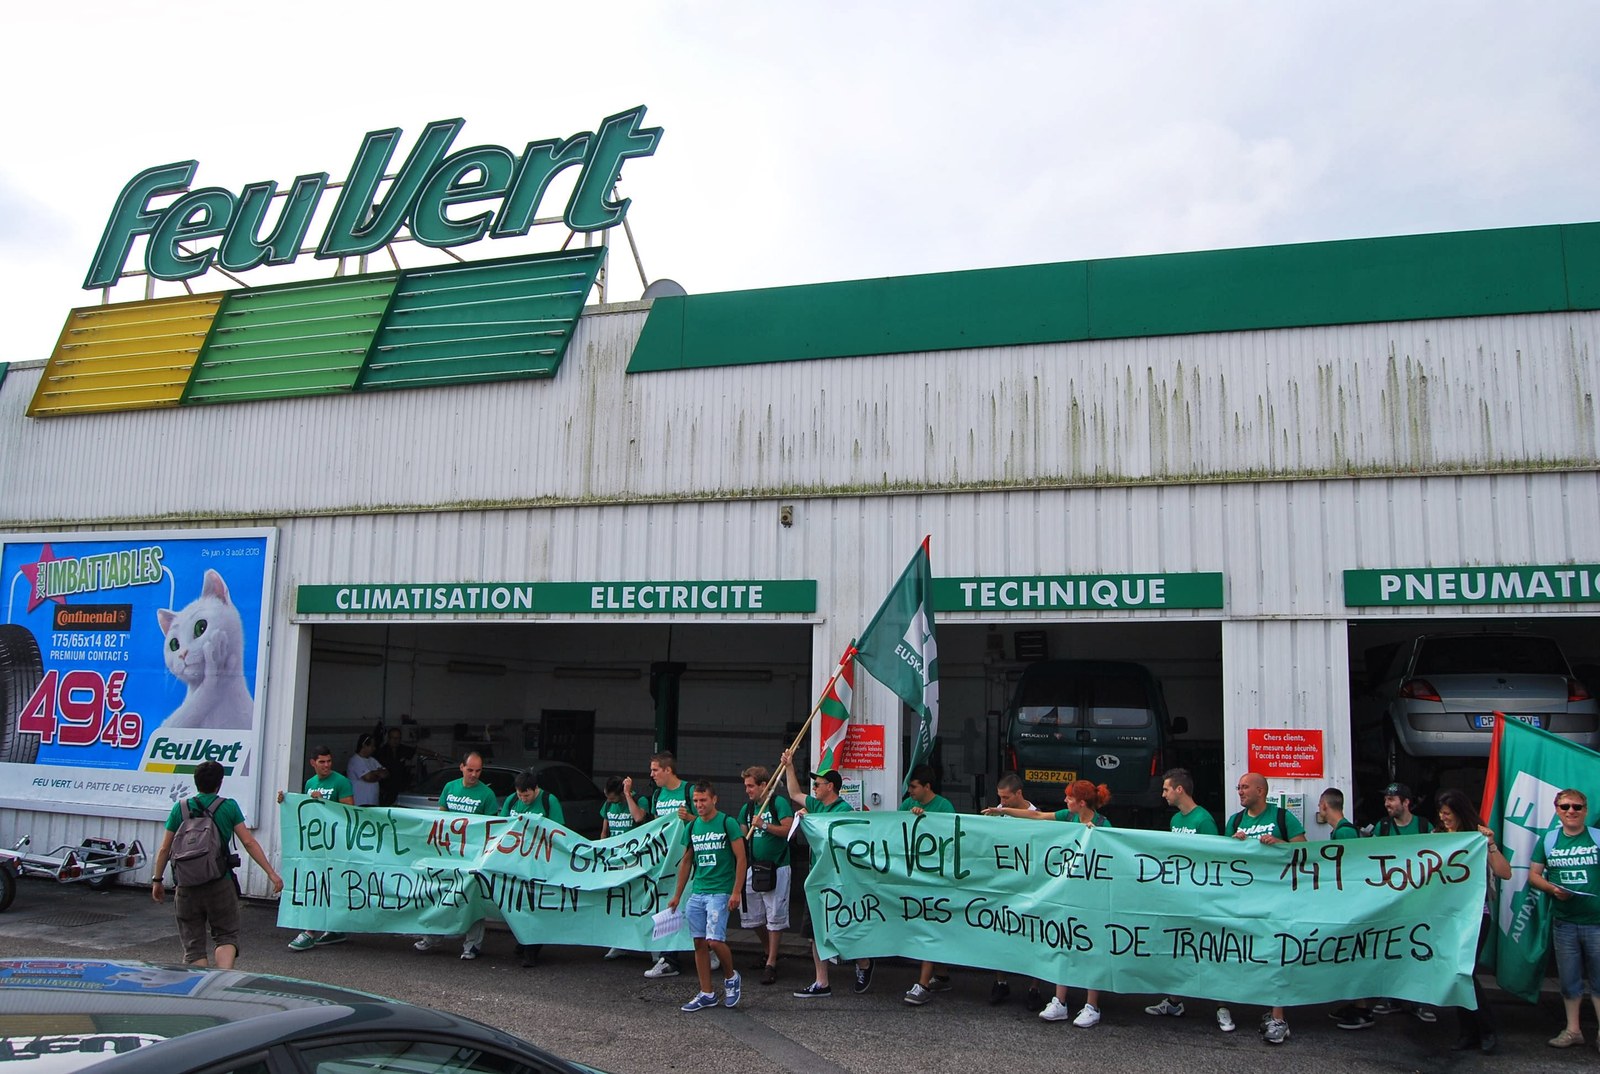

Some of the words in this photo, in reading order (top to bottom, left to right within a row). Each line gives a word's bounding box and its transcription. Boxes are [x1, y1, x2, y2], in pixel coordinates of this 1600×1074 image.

[225, 548, 231, 556] 3
[46, 545, 163, 597] IMBATTABLES
[959, 578, 1167, 608] TECHNIQUE
[1379, 570, 1600, 601] PNEUMATI
[335, 587, 534, 610] CLIMATISATION
[590, 584, 763, 609] ELECTRICITE
[56, 610, 118, 626] Continental
[52, 634, 101, 648] 175/65x14
[104, 634, 116, 648] 82
[50, 650, 85, 661] PREMIUM
[88, 650, 122, 661] CONTACT
[123, 651, 129, 662] 5
[894, 643, 925, 682] EUSKA
[1251, 743, 1261, 751] Par
[1263, 733, 1282, 741] Chers
[1283, 733, 1306, 742] clients,
[1292, 752, 1315, 760] ateliers
[32, 777, 49, 787] FEU
[73, 780, 84, 789] LA
[85, 781, 111, 791] PATTE
[112, 783, 125, 792] DE
[126, 785, 166, 796] L'EXPERT
[1028, 770, 1049, 780] 3929
[1050, 771, 1062, 781] PZ
[1062, 772, 1073, 782] 40
[298, 799, 339, 851] Feu
[344, 806, 410, 855] Vert
[426, 817, 469, 857] 149
[828, 818, 890, 874] Feu
[902, 813, 971, 880] Vert
[993, 843, 1029, 875] EN
[1044, 838, 1114, 881] GRÈVE
[1134, 853, 1254, 886] DEPUIS
[1279, 844, 1345, 891] 149
[1365, 849, 1471, 891] JOURS
[291, 867, 334, 907] LAN
[341, 867, 469, 911] BALDINTZA
[820, 887, 886, 933] POUR
[899, 896, 952, 924] DES
[965, 897, 1094, 952] CONDITIONS
[1104, 923, 1151, 957] DE
[1163, 926, 1268, 963] TRAVAIL
[1274, 922, 1434, 967] DÉCENTES
